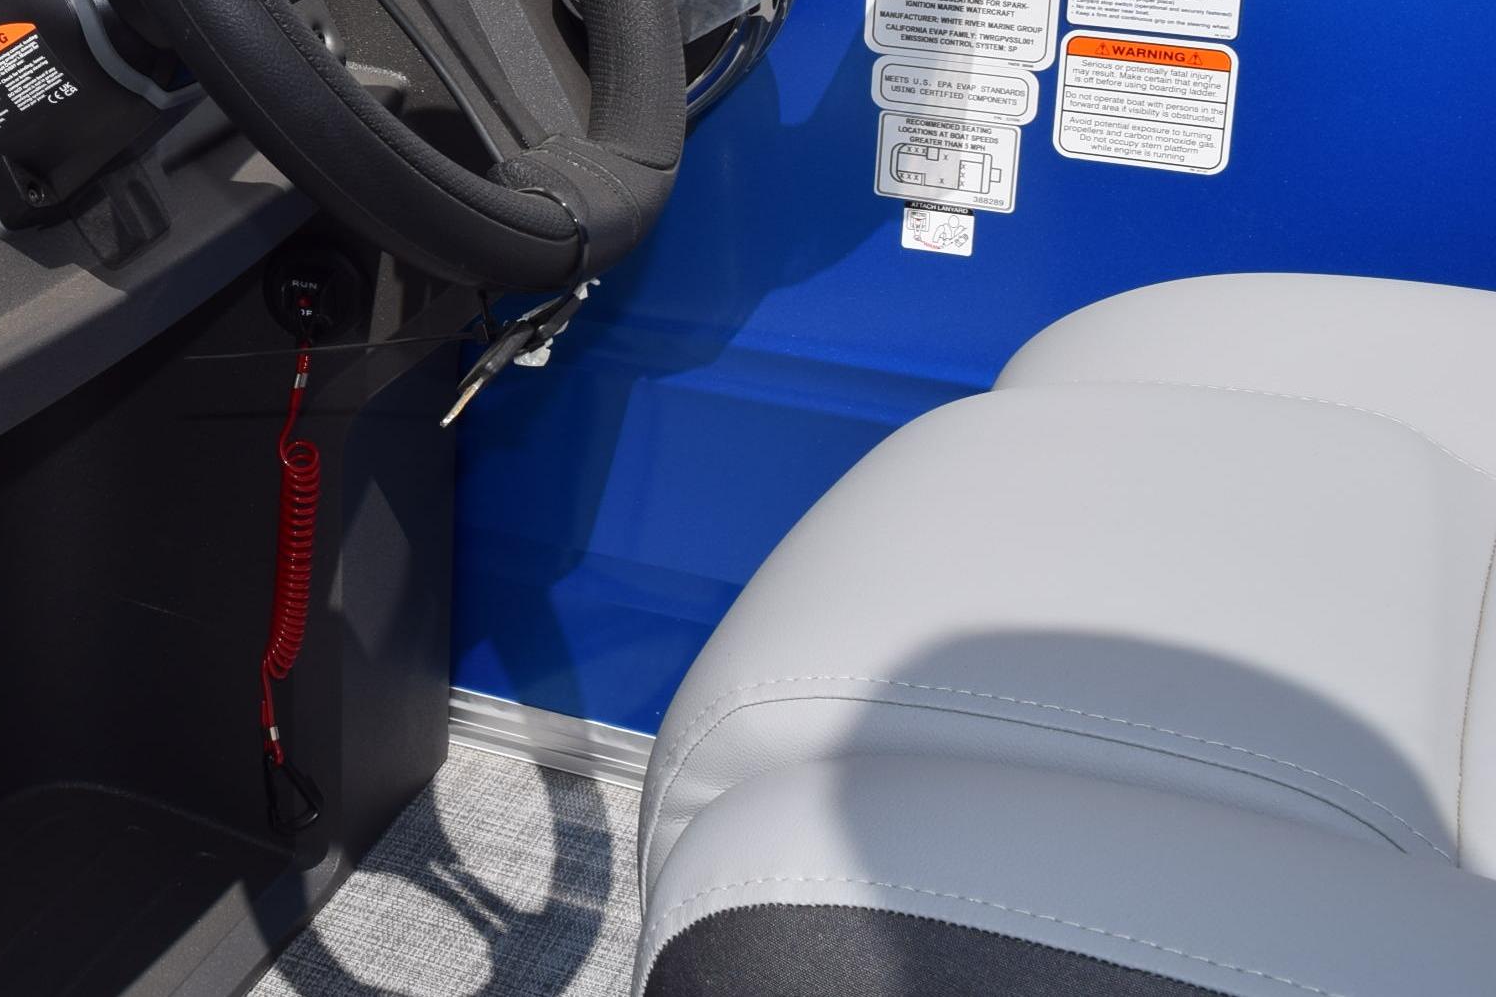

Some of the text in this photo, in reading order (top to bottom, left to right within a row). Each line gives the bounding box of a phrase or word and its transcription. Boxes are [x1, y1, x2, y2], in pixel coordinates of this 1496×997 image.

[906, 1, 1015, 17] IGNITION MARINE WATERCRAFT
[985, 0, 1001, 7] FOR
[881, 12, 1043, 34] MANUFACTURER: WHITE RIVER MARINE GROUP
[886, 24, 928, 35] CALIFORNIA
[928, 28, 948, 37] EVAP
[1113, 45, 1186, 63] WARNING
[886, 75, 910, 85] MEETS
[937, 81, 953, 89] EPA
[956, 83, 976, 92] EVAP
[980, 85, 1026, 97] STANDARDS
[892, 86, 1017, 106] USING CERTIFIED COMPONENTS
[907, 119, 992, 135] RECOMMENDED SEATING
[899, 127, 999, 144] LOCATIONS AT BOAT SPEEDS
[911, 136, 943, 147] GREATER
[944, 140, 963, 149] THAN
[970, 143, 986, 151] MPH
[912, 202, 969, 214] ATTACH LANYARD
[292, 279, 318, 290] RUN
